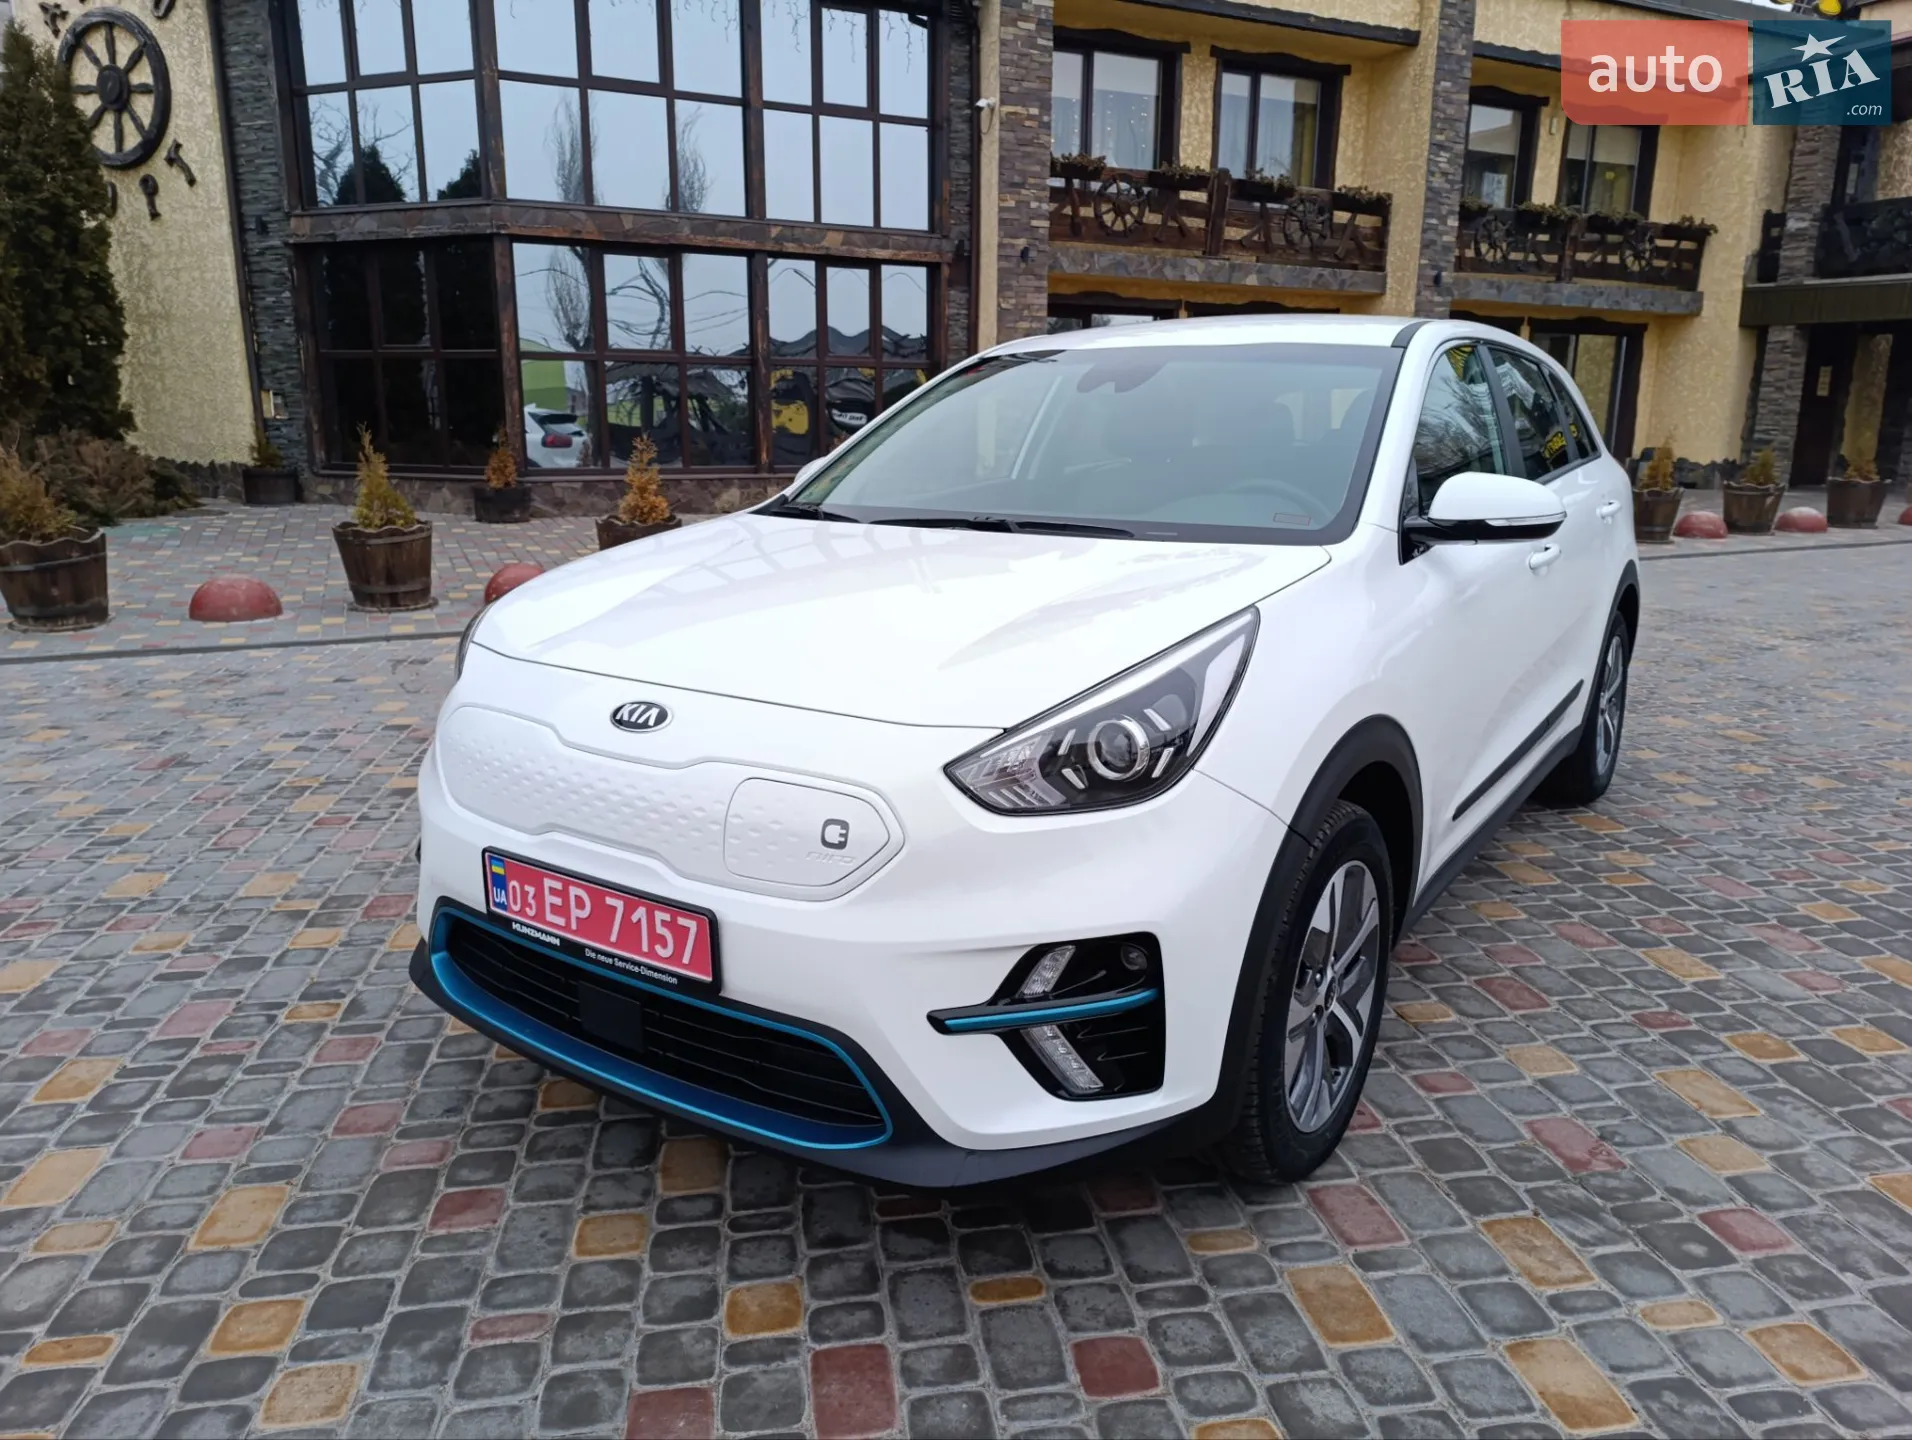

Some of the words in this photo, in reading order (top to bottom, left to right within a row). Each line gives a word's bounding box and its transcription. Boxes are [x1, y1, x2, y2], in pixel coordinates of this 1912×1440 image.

[614, 703, 661, 727] KIA
[493, 886, 508, 905] UA
[508, 880, 537, 917] 03
[543, 877, 592, 930] EP
[605, 897, 698, 965] 7157
[584, 947, 597, 959] Die
[597, 953, 614, 965] neue
[614, 957, 678, 985] Service-Dimension
